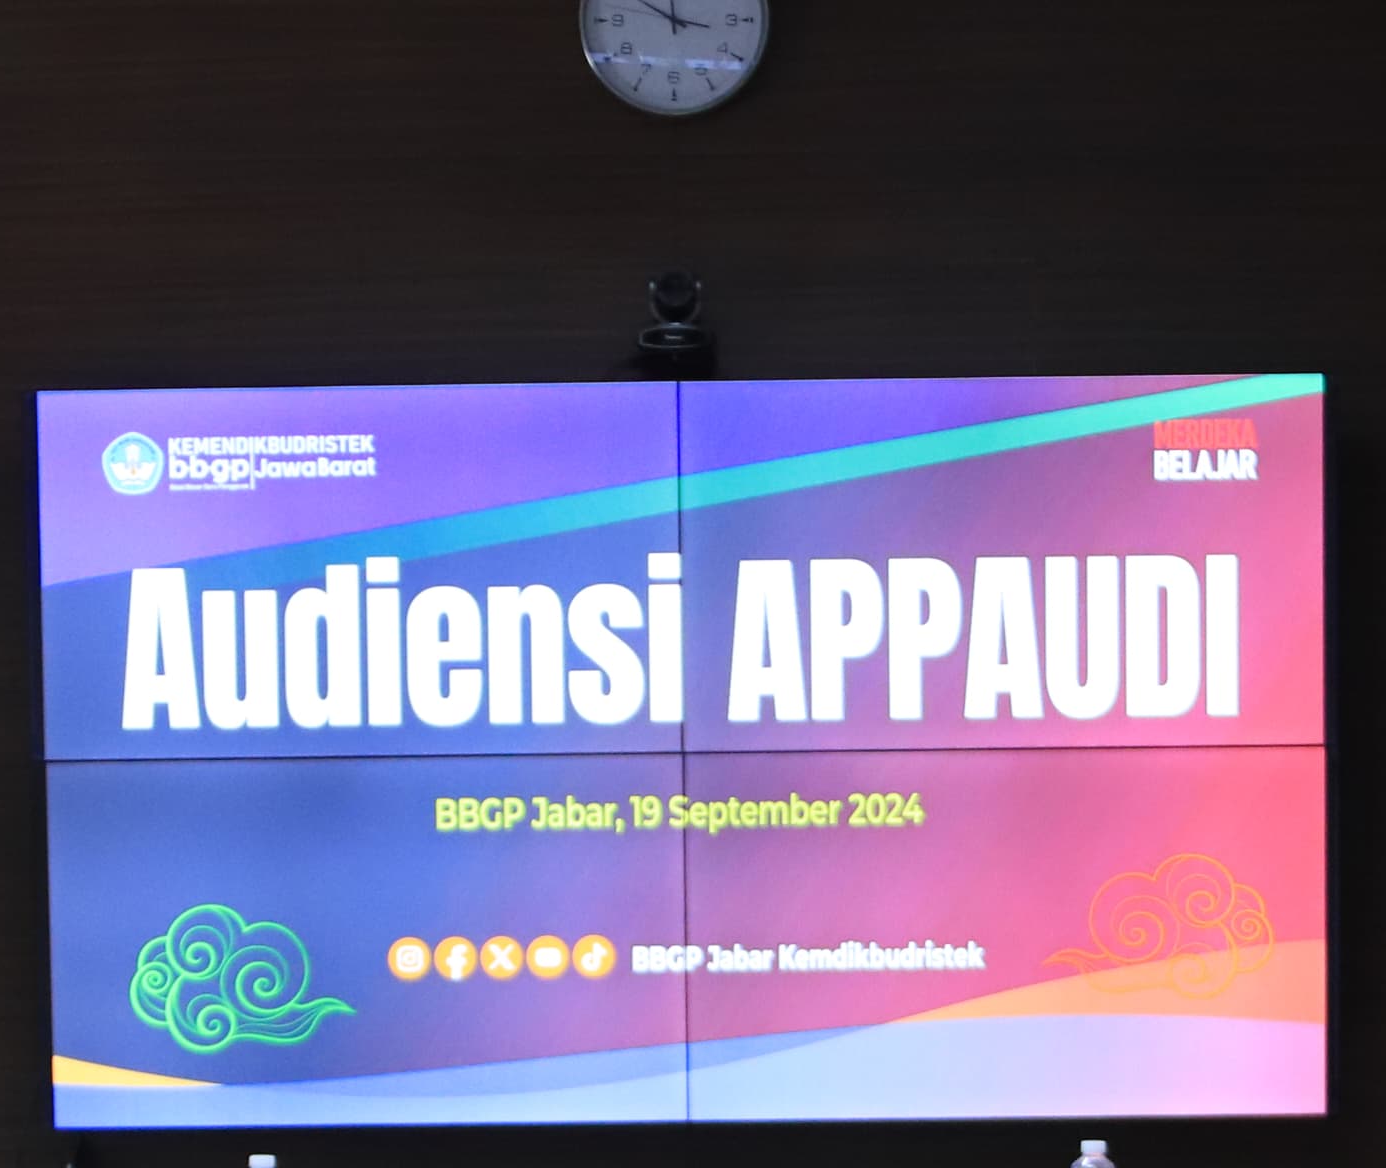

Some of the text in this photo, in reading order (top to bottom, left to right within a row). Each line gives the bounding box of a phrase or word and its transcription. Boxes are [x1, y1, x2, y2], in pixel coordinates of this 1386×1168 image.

[168, 435, 375, 455] KEMENDIKBUDRISTEK
[1153, 419, 1259, 449] MERDEKA
[1153, 448, 1259, 481] BELAJAR
[121, 552, 1240, 730] Audiensi APPAUDI
[435, 792, 926, 834] BBGP Jabar, 19 September 2024
[630, 944, 703, 974] BBGP
[706, 944, 773, 972] Jabar
[777, 940, 987, 972] Kemdikbudristek
